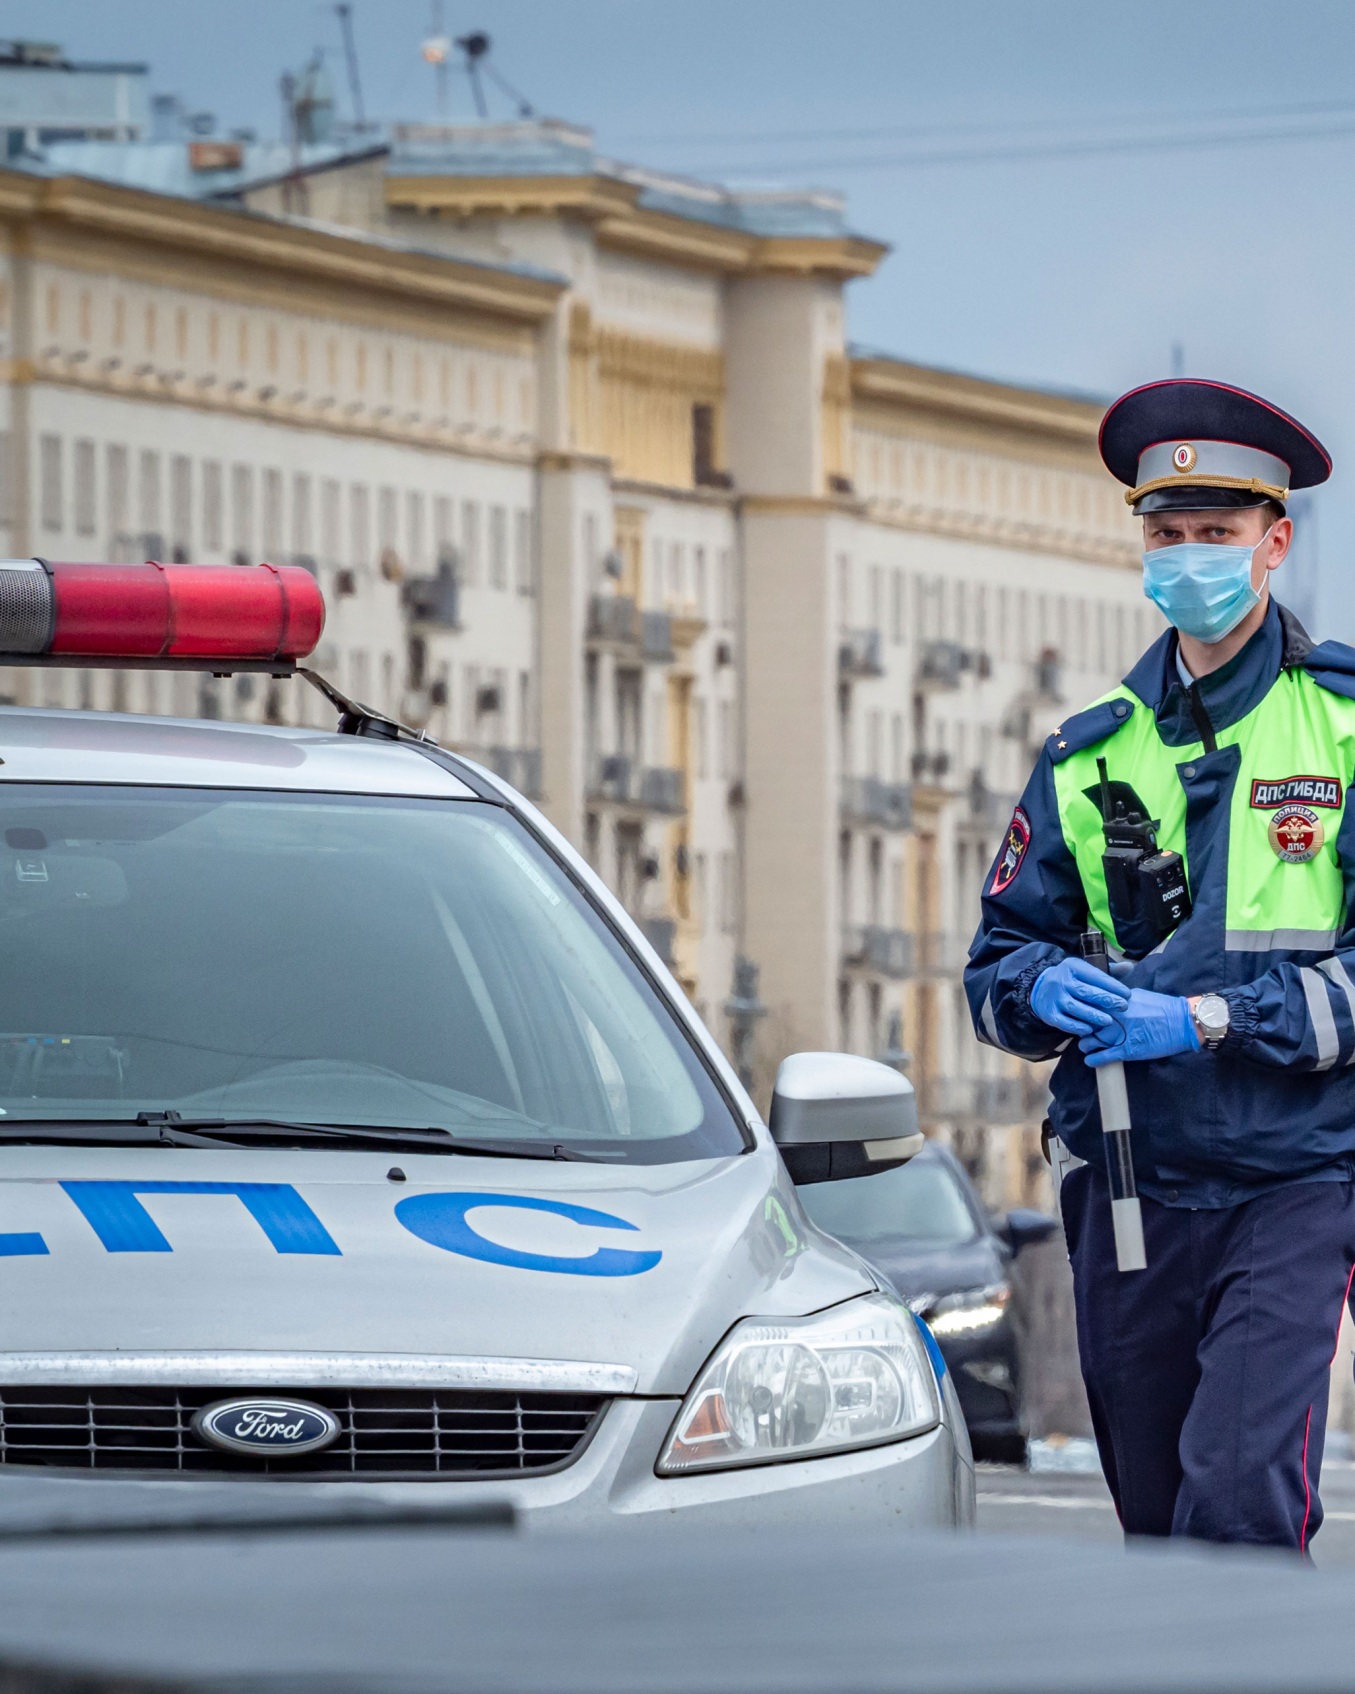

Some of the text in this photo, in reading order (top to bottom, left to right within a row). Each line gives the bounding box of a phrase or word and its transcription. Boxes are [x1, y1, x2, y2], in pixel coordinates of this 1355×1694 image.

[1286, 781, 1337, 803] ГИБДД
[1273, 806, 1318, 823] ПОЛИЦИЯ
[1287, 842, 1306, 852] ДПС
[1162, 885, 1185, 902] DOZOR
[234, 1409, 305, 1439] Ford
